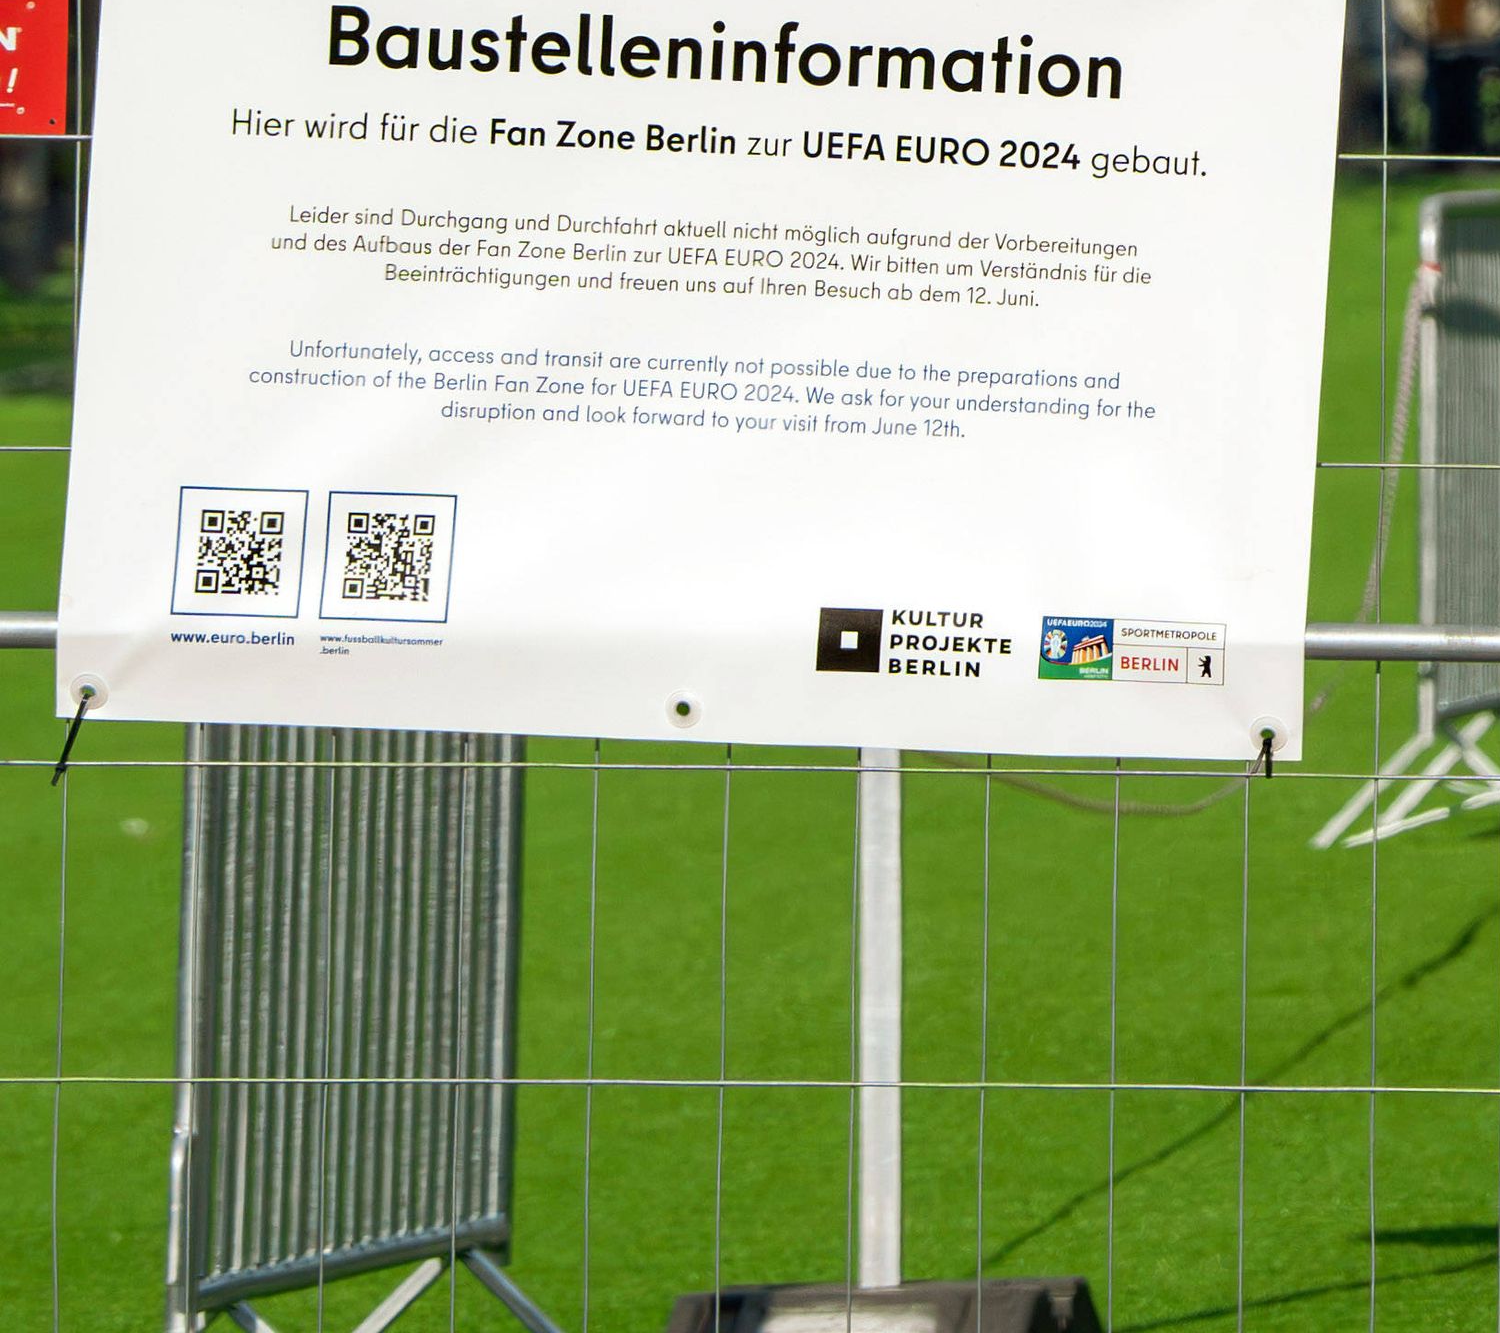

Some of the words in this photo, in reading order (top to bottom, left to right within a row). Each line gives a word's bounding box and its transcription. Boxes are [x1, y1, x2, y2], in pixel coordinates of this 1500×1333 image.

[329, 5, 1121, 99] Baustelleninformation
[233, 109, 294, 137] Hier
[305, 112, 367, 140] wird
[381, 112, 419, 142] für
[430, 115, 477, 144] die
[490, 118, 545, 147] Fan
[556, 120, 635, 151] Zone
[646, 123, 735, 154] Berlin
[748, 137, 792, 157] zur
[804, 130, 885, 161] UEFA
[896, 135, 989, 166] EURO
[1000, 139, 1080, 170] 2024
[1092, 145, 1206, 179] gebaut.
[290, 205, 349, 224] Leider
[355, 207, 393, 225] sind
[402, 208, 507, 235] Durchgang
[515, 213, 549, 231] und
[558, 214, 657, 235] Durchfahrt
[664, 219, 726, 239] aktuell
[734, 222, 777, 240] nicht
[785, 225, 859, 247] möglich
[867, 227, 951, 251] aufgrund
[958, 231, 989, 250] der
[995, 233, 1137, 260] Vorbereitungen
[272, 233, 307, 251] und
[314, 233, 346, 252] des
[353, 235, 431, 255] Aufbaus
[439, 237, 470, 256] der
[477, 239, 510, 257] Fan
[518, 240, 565, 259] Zone
[573, 242, 626, 262] Berlin
[634, 250, 661, 264] zur
[669, 246, 718, 266] UEFA
[725, 249, 783, 268] EURO
[791, 250, 844, 271] 2024.
[851, 254, 881, 272] Wir
[887, 255, 938, 274] bitten
[946, 263, 972, 277] um
[980, 259, 1086, 282] Verständnis
[1094, 264, 1117, 283] für
[1123, 266, 1151, 284] die
[385, 263, 570, 291] Beeinträchtigungen
[578, 271, 612, 289] und
[620, 272, 678, 292] freuen
[686, 280, 716, 293] uns
[723, 275, 754, 294] auf
[761, 277, 806, 296] Ihren
[815, 279, 880, 300] Besuch
[888, 283, 912, 301] ab
[920, 284, 960, 303] dem
[967, 286, 991, 305] 12.
[997, 288, 1038, 307] Juni.
[291, 340, 421, 366] Unfortunately,
[429, 349, 494, 365] access
[501, 348, 538, 366] and
[545, 350, 603, 368] transit
[610, 356, 641, 370] are
[648, 354, 728, 377] currently
[735, 358, 764, 374] not
[771, 358, 849, 378] possible
[856, 360, 891, 379] due
[899, 364, 915, 380] to
[924, 363, 950, 382] the
[958, 369, 1077, 389] preparations
[1084, 371, 1120, 389] and
[249, 368, 365, 387] construction
[373, 370, 392, 388] of
[398, 370, 426, 390] the
[434, 373, 486, 391] Berlin
[495, 374, 528, 393] Fan
[536, 375, 584, 395] Zone
[592, 376, 616, 396] for
[624, 379, 672, 398] UEFA
[681, 381, 737, 401] EURO
[744, 383, 799, 403] 2024.
[806, 386, 834, 404] We
[841, 389, 872, 406] ask
[880, 388, 904, 407] for
[910, 396, 950, 412] your
[957, 394, 1089, 421] understanding
[1098, 398, 1121, 417] for
[1128, 400, 1155, 418] the
[892, 609, 984, 628] KULTUR
[171, 630, 295, 646] www.euro.berlin
[319, 634, 443, 646] www.fussballkultursommer
[890, 634, 1012, 654] PROJEKTE
[1121, 627, 1218, 641] SPORTMETROPOLE
[319, 647, 350, 655] .berlin
[888, 658, 980, 677] BERLIN
[1120, 656, 1179, 672] BERLIN
